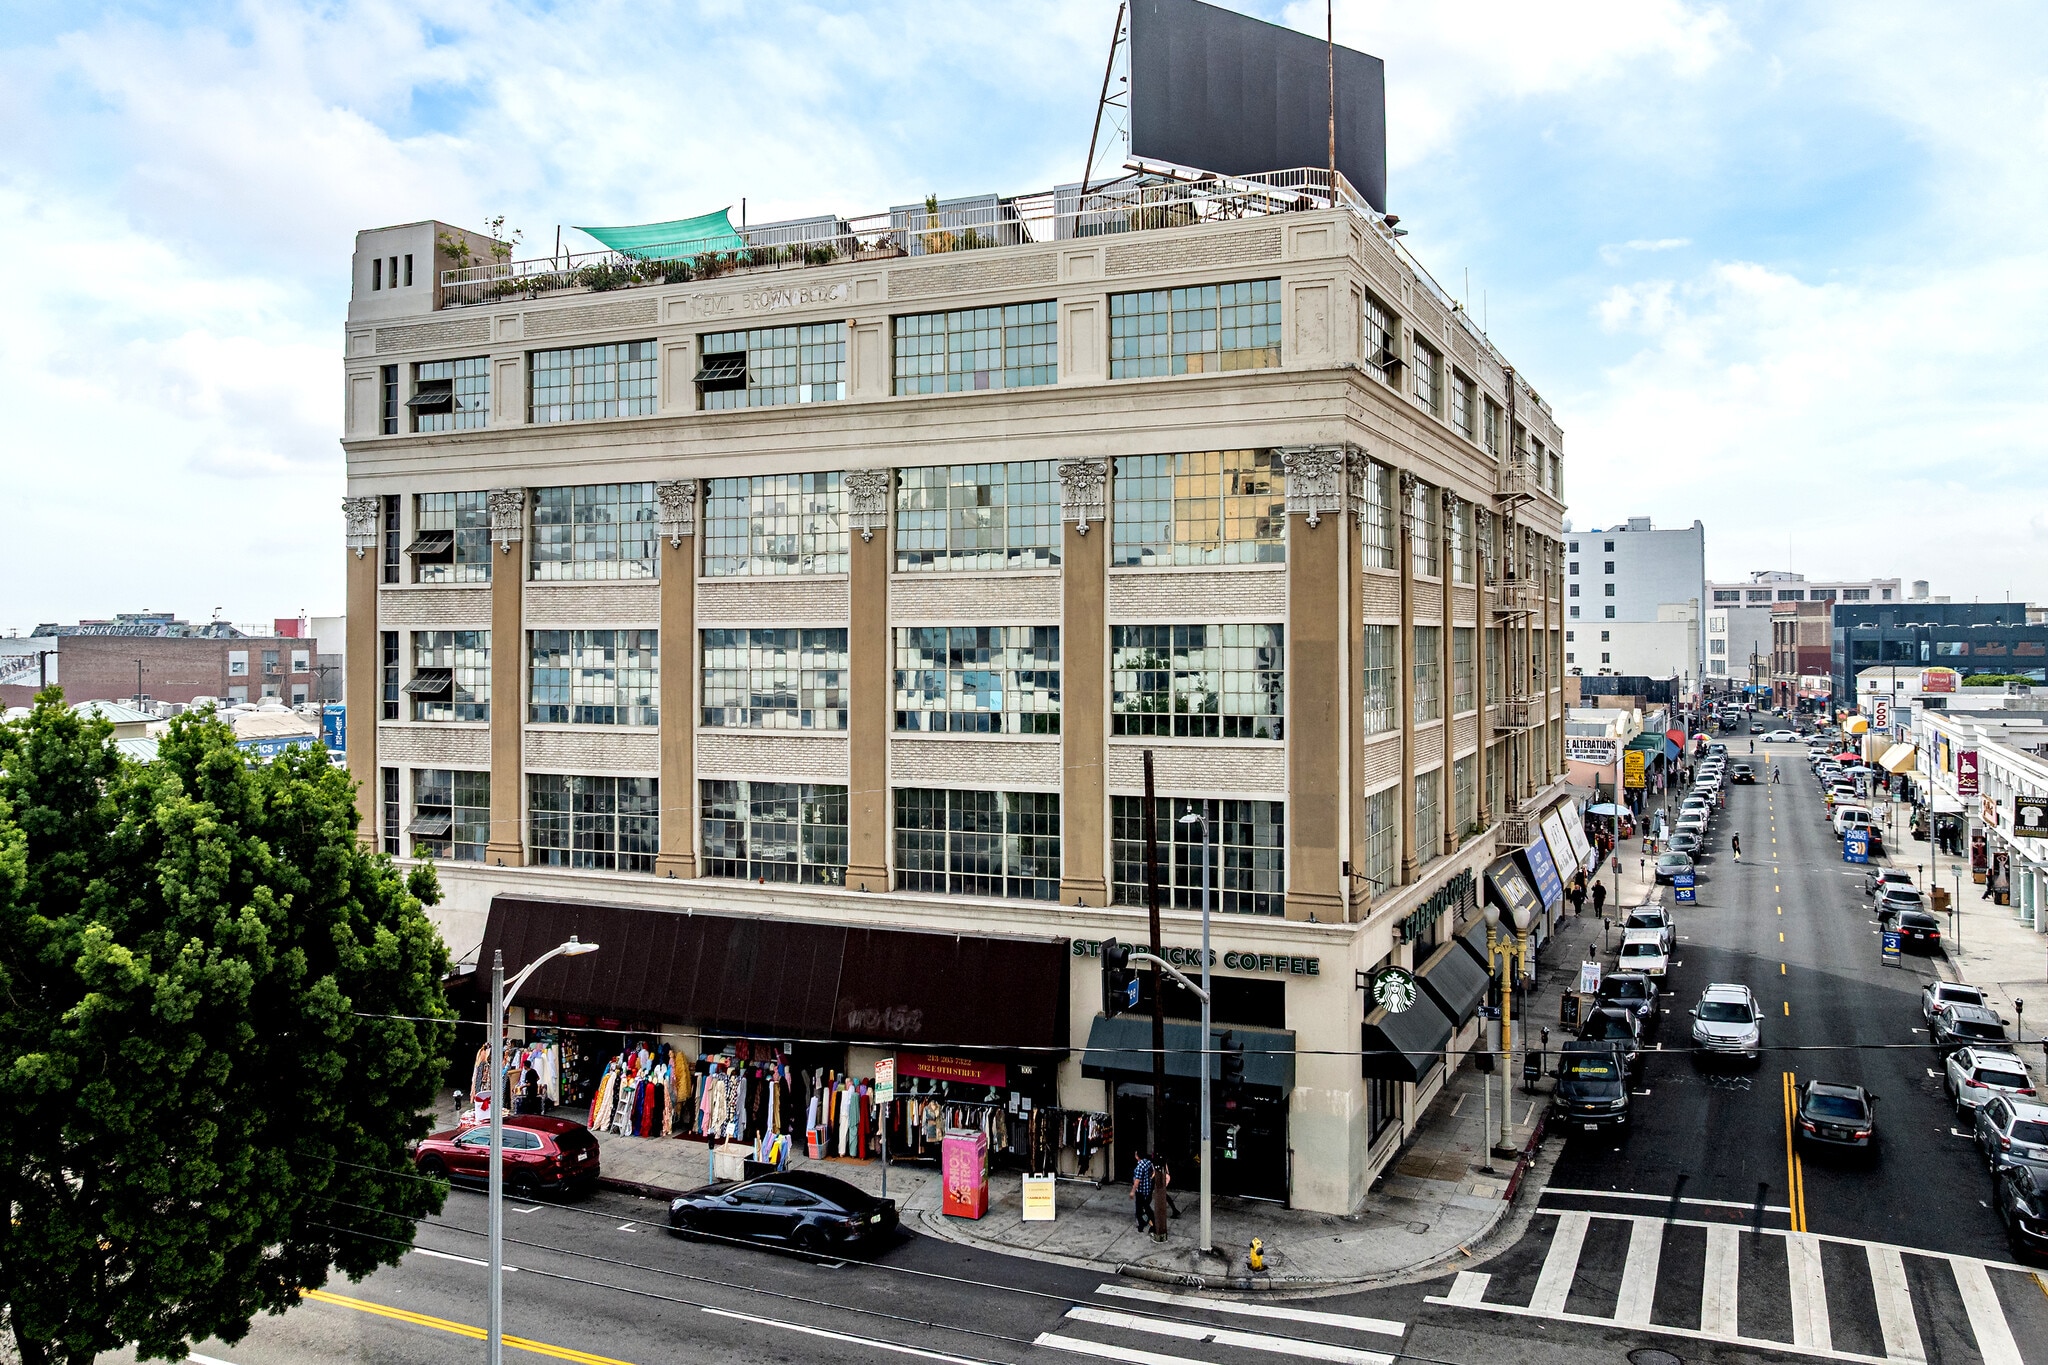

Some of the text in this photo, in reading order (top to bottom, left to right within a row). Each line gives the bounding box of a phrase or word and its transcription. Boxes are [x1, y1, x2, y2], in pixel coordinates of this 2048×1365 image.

[1876, 702, 1886, 727] FOOD
[335, 716, 343, 745] LEVINE
[1572, 740, 1615, 749] ALTERATIONS
[1402, 886, 1449, 945] STARBUCKS
[1223, 950, 1320, 977] COFFEE
[917, 1063, 931, 1073] 302
[937, 1065, 952, 1075] 9TH
[952, 1066, 981, 1078] STREET
[960, 1149, 972, 1205] DISTRICT
